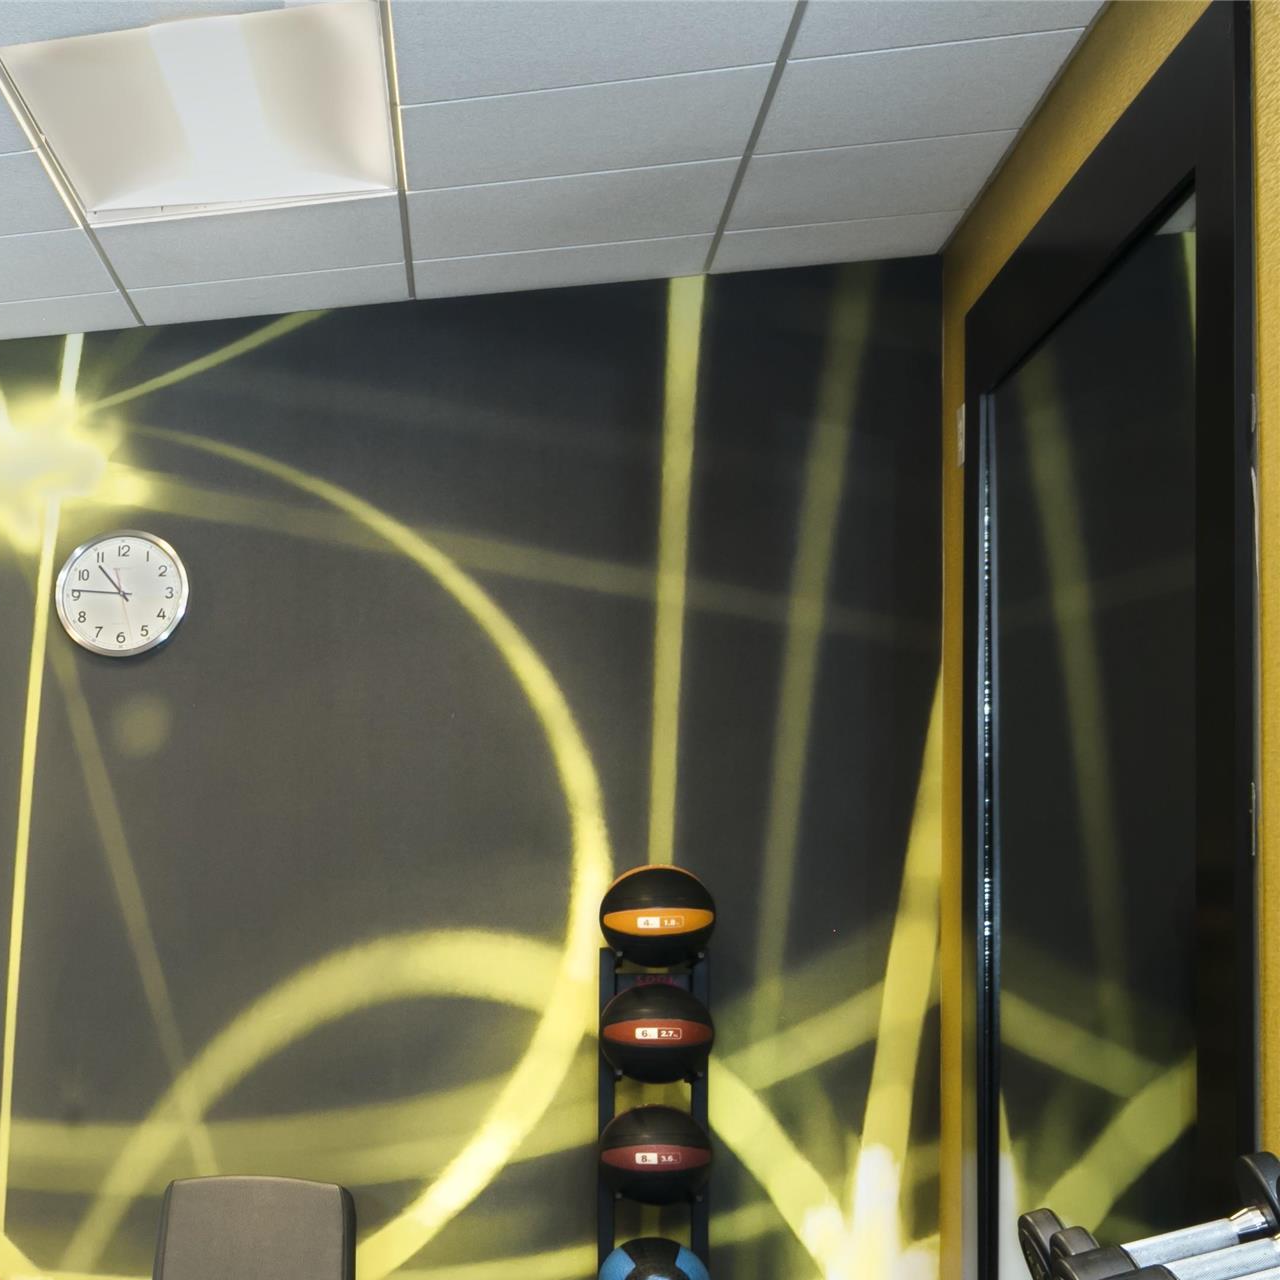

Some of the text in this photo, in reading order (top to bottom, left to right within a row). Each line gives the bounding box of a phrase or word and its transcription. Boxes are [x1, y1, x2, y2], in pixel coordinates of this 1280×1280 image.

[118, 544, 131, 557] 12
[146, 551, 149, 562] 1
[97, 552, 104, 563] 11
[78, 568, 90, 581] 10
[158, 565, 168, 577] 2
[72, 589, 81, 601] 9
[165, 586, 174, 599] 3
[77, 611, 87, 623] 8
[156, 608, 166, 620] 4
[95, 626, 103, 638] 7
[140, 625, 149, 637] 5
[116, 632, 126, 644] 6
[641, 1029, 648, 1037] 6
[641, 1154, 648, 1162] 8
